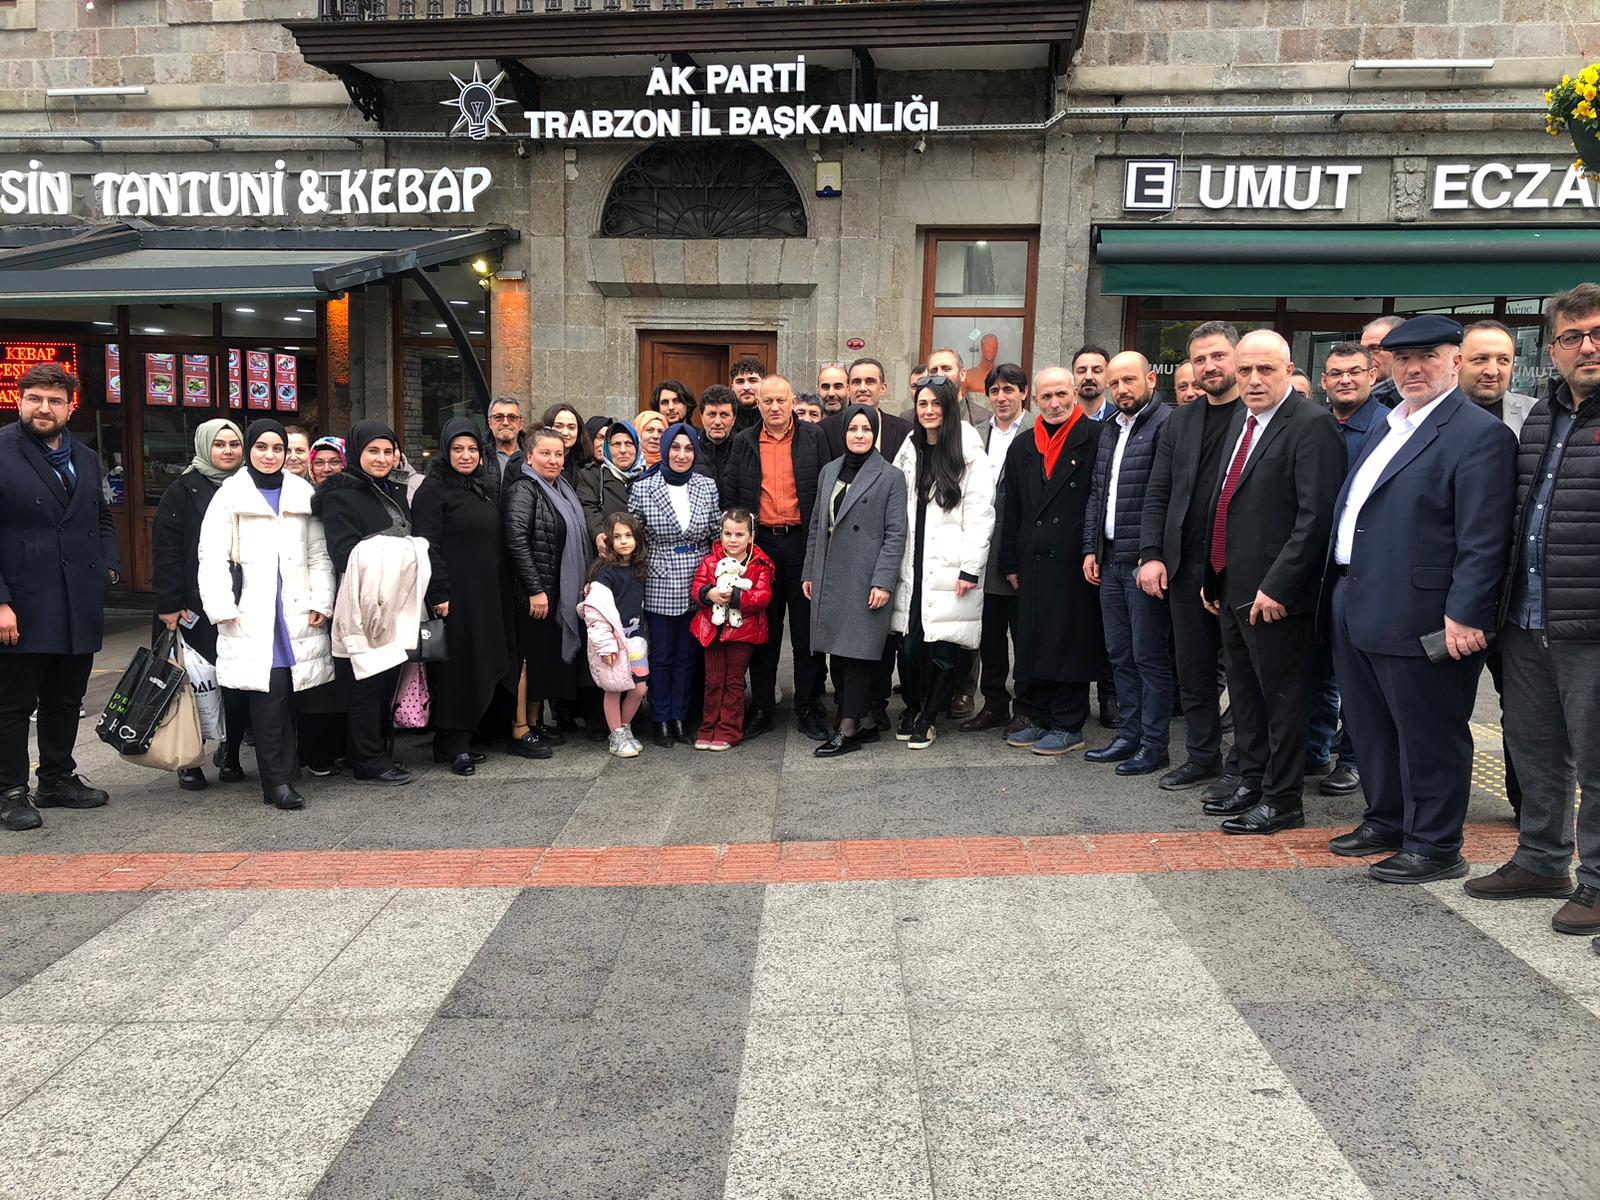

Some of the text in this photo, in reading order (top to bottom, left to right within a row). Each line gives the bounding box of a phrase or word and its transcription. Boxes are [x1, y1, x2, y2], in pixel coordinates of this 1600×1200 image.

[645, 54, 806, 96] AK PARTİ
[523, 94, 939, 140] TRABZON İL BAŞKANLIĞI
[94, 158, 288, 216] TANTUNİ
[298, 169, 331, 214] &
[340, 166, 493, 214] KEBAP
[1199, 162, 1600, 210] UMUT ECZA
[5, 346, 56, 361] KEBAP
